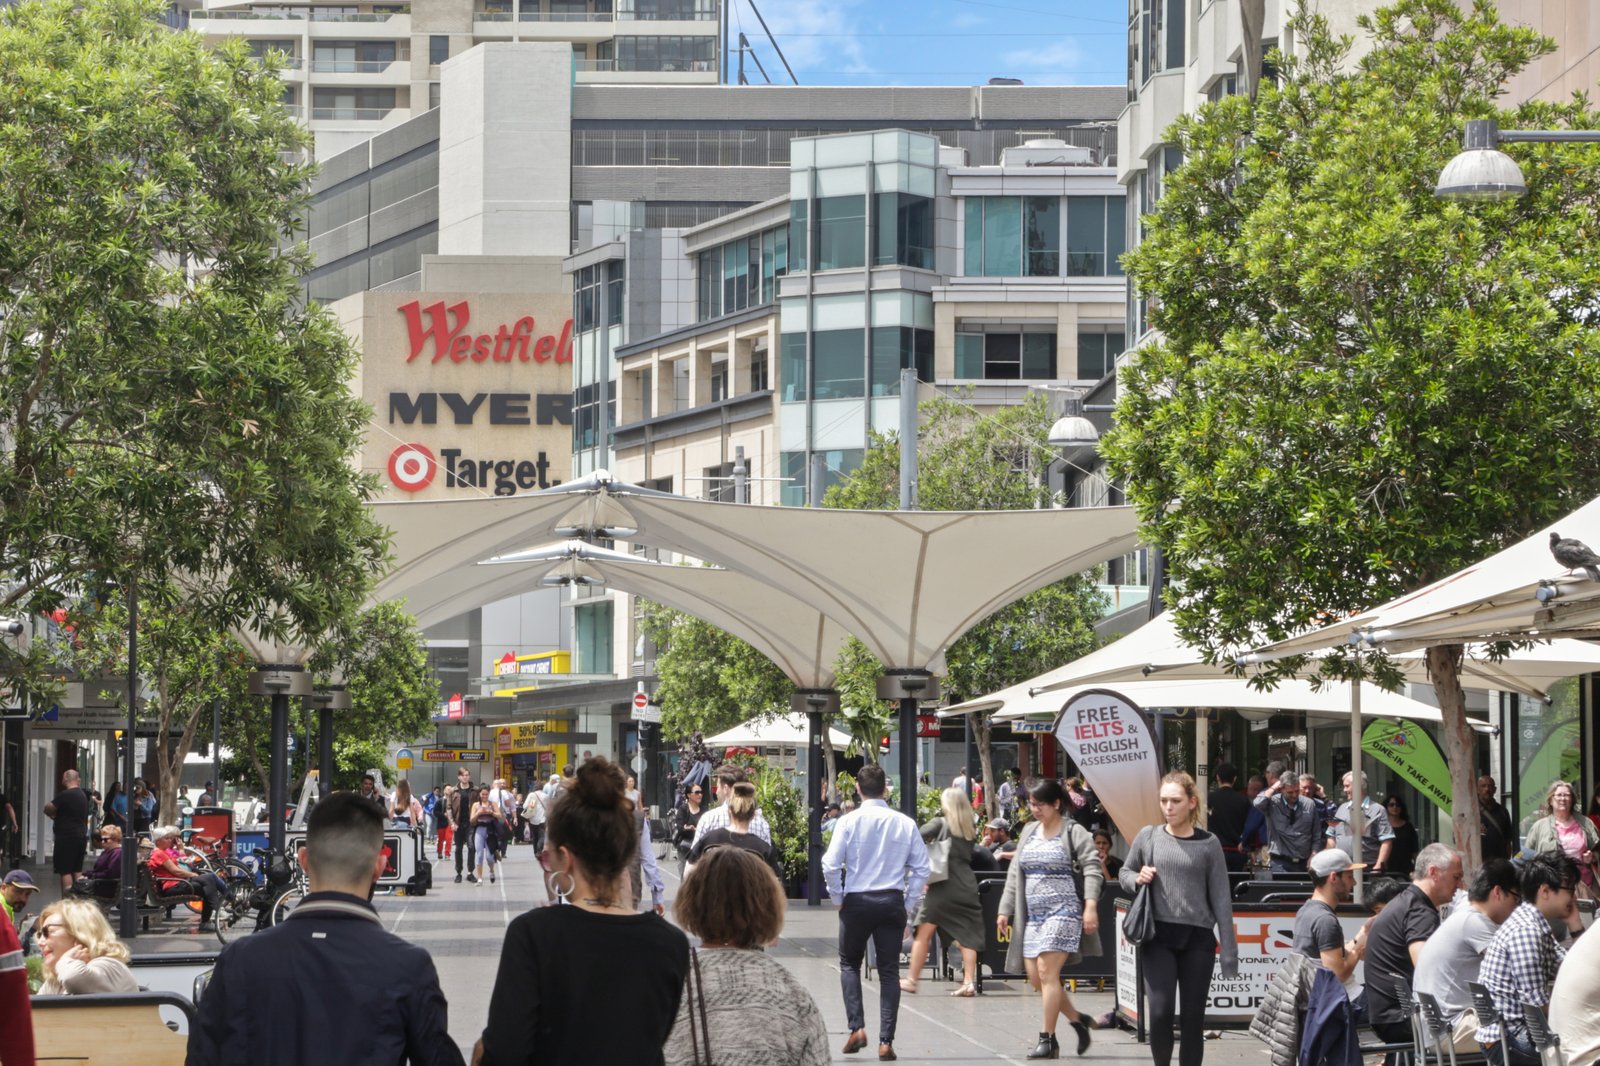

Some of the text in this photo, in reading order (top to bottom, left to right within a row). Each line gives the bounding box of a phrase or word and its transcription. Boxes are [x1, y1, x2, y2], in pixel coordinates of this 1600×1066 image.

[388, 392, 573, 425] MYER
[440, 449, 562, 496] Target.
[1077, 706, 1120, 724] FREE
[1075, 720, 1138, 740] IELTS &
[1079, 738, 1139, 755] ENGLISH
[1080, 751, 1148, 766] ASSESSMENT
[1372, 741, 1453, 805] DINE-IN TAKE AWAY
[1237, 957, 1280, 965] YDNEY,
[1210, 983, 1251, 993] SINESS
